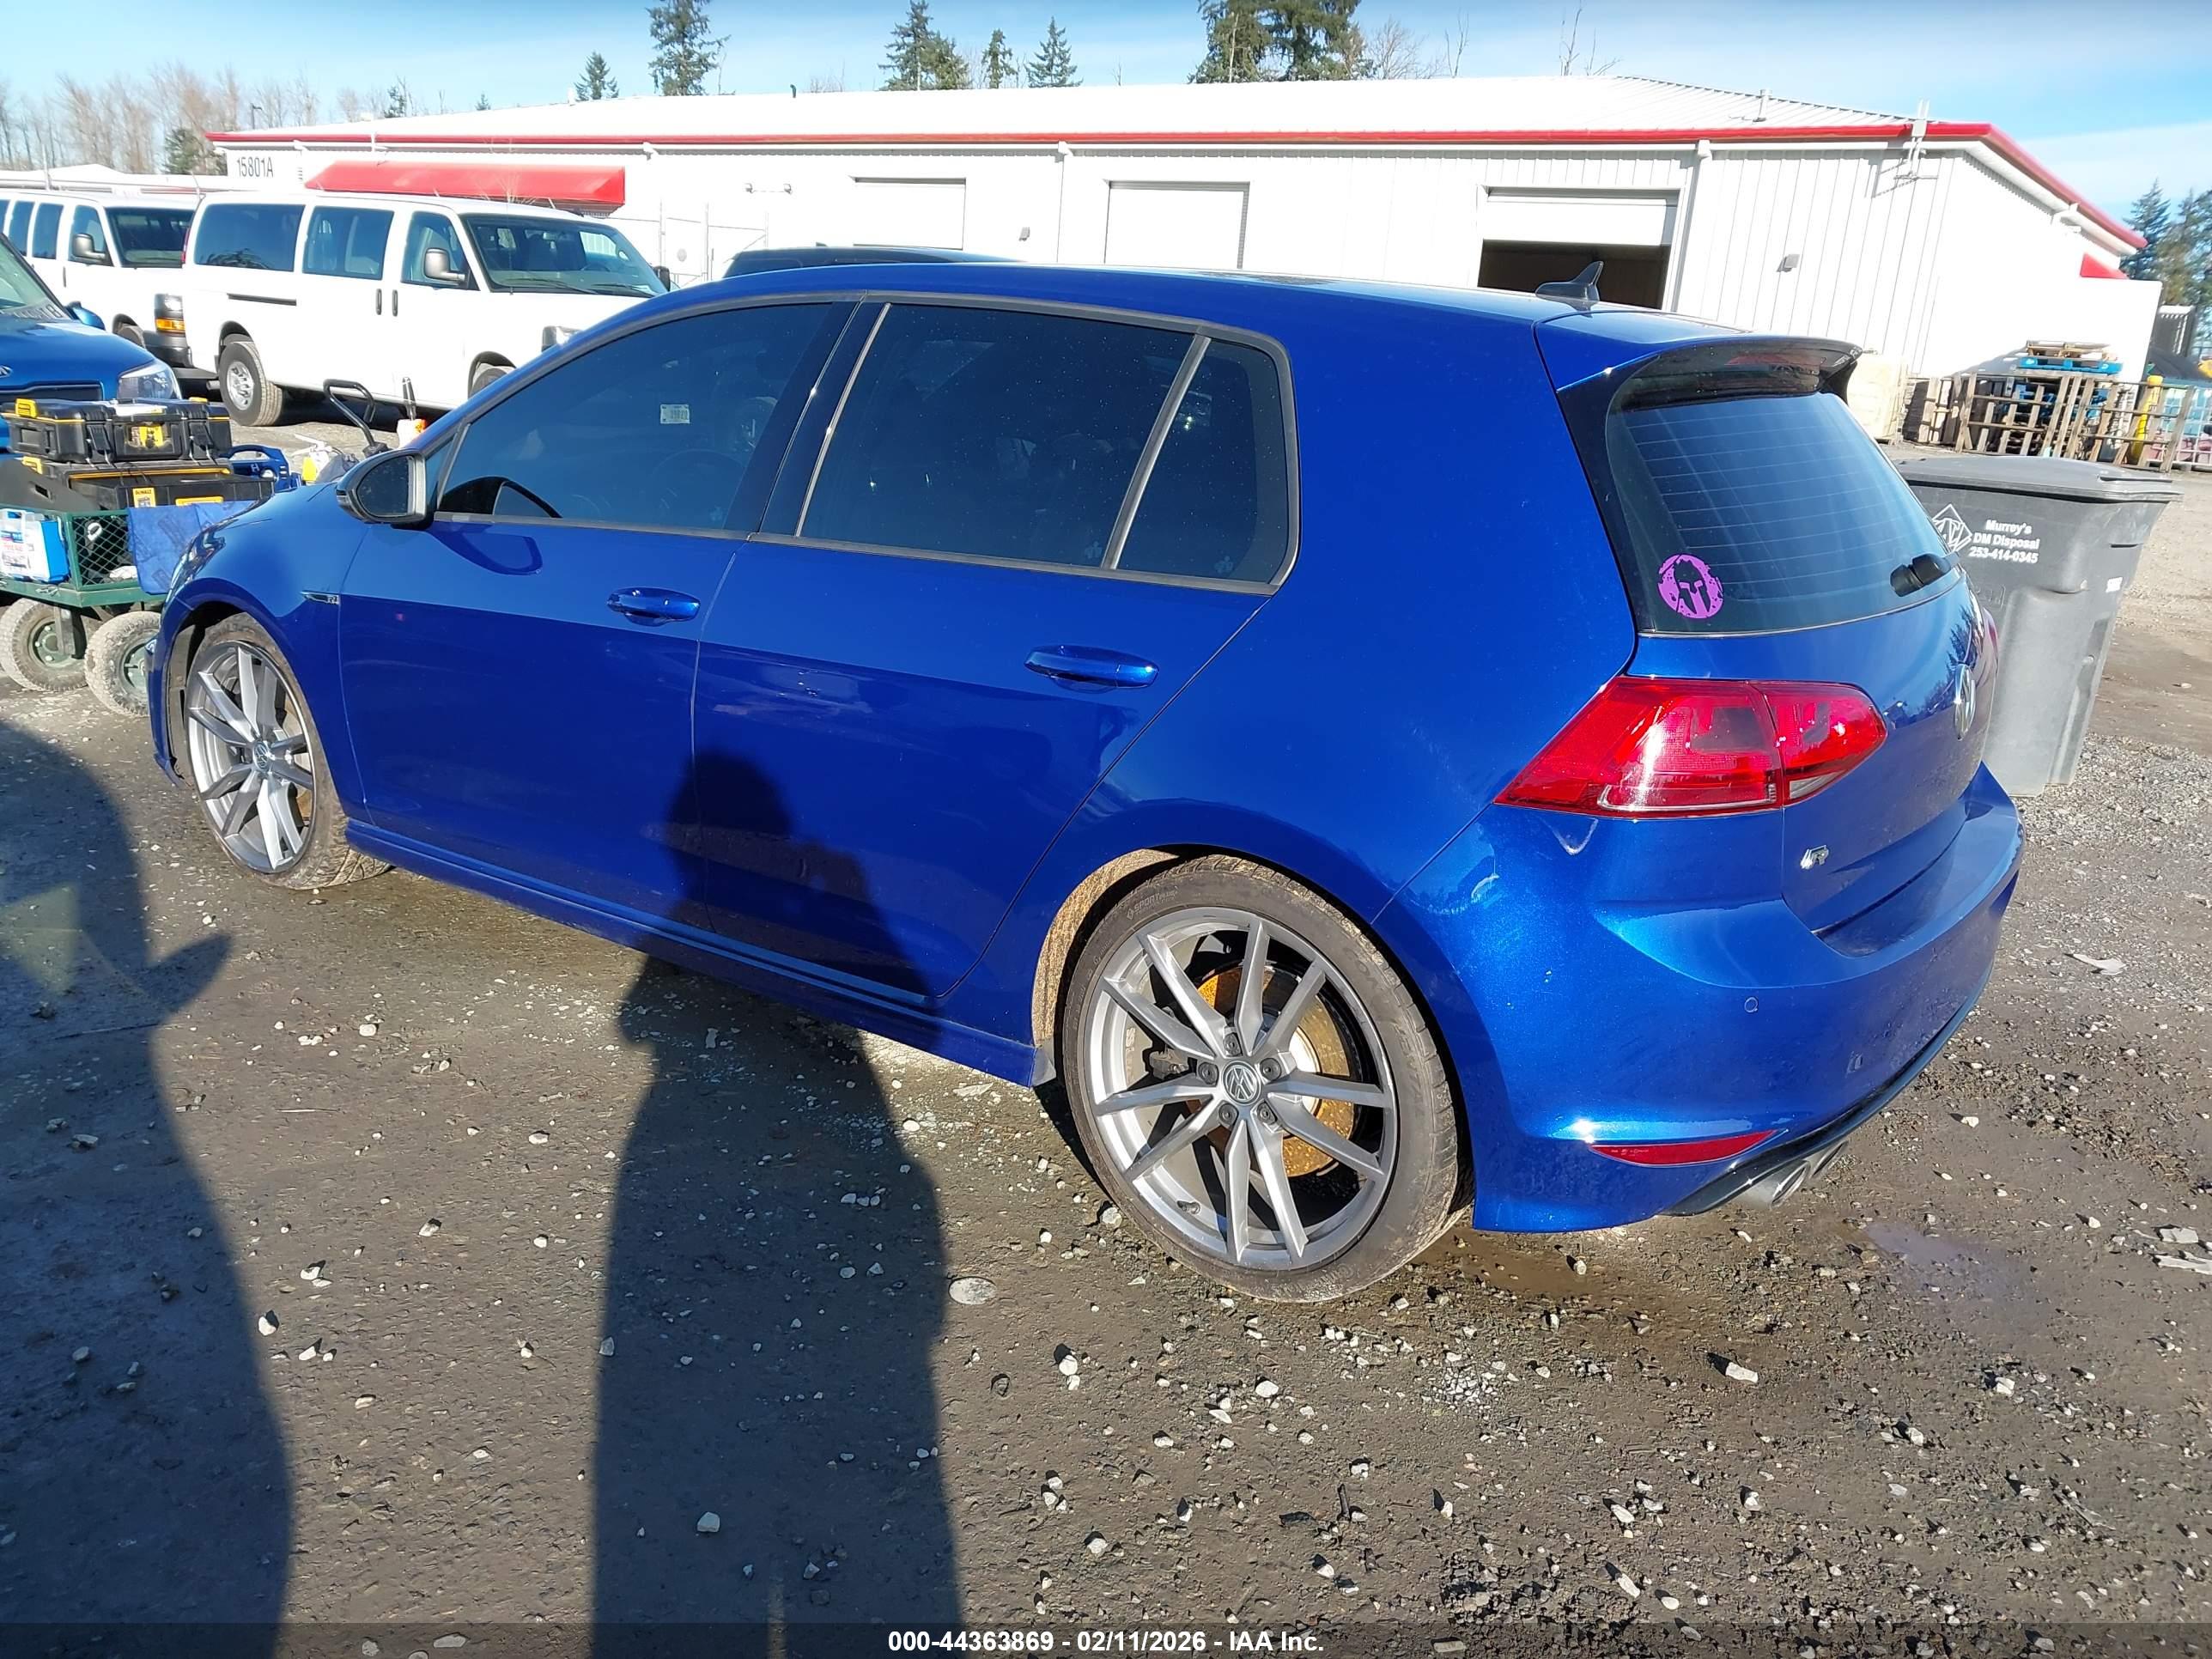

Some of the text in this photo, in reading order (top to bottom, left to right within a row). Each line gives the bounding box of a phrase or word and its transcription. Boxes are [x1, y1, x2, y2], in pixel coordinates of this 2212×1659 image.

[236, 156, 274, 178] 15801A
[1984, 519, 2033, 537] Murrey's
[1972, 532, 1992, 545] DM
[1991, 533, 2041, 550] Disposal
[1968, 545, 2039, 564] 253-414-0345
